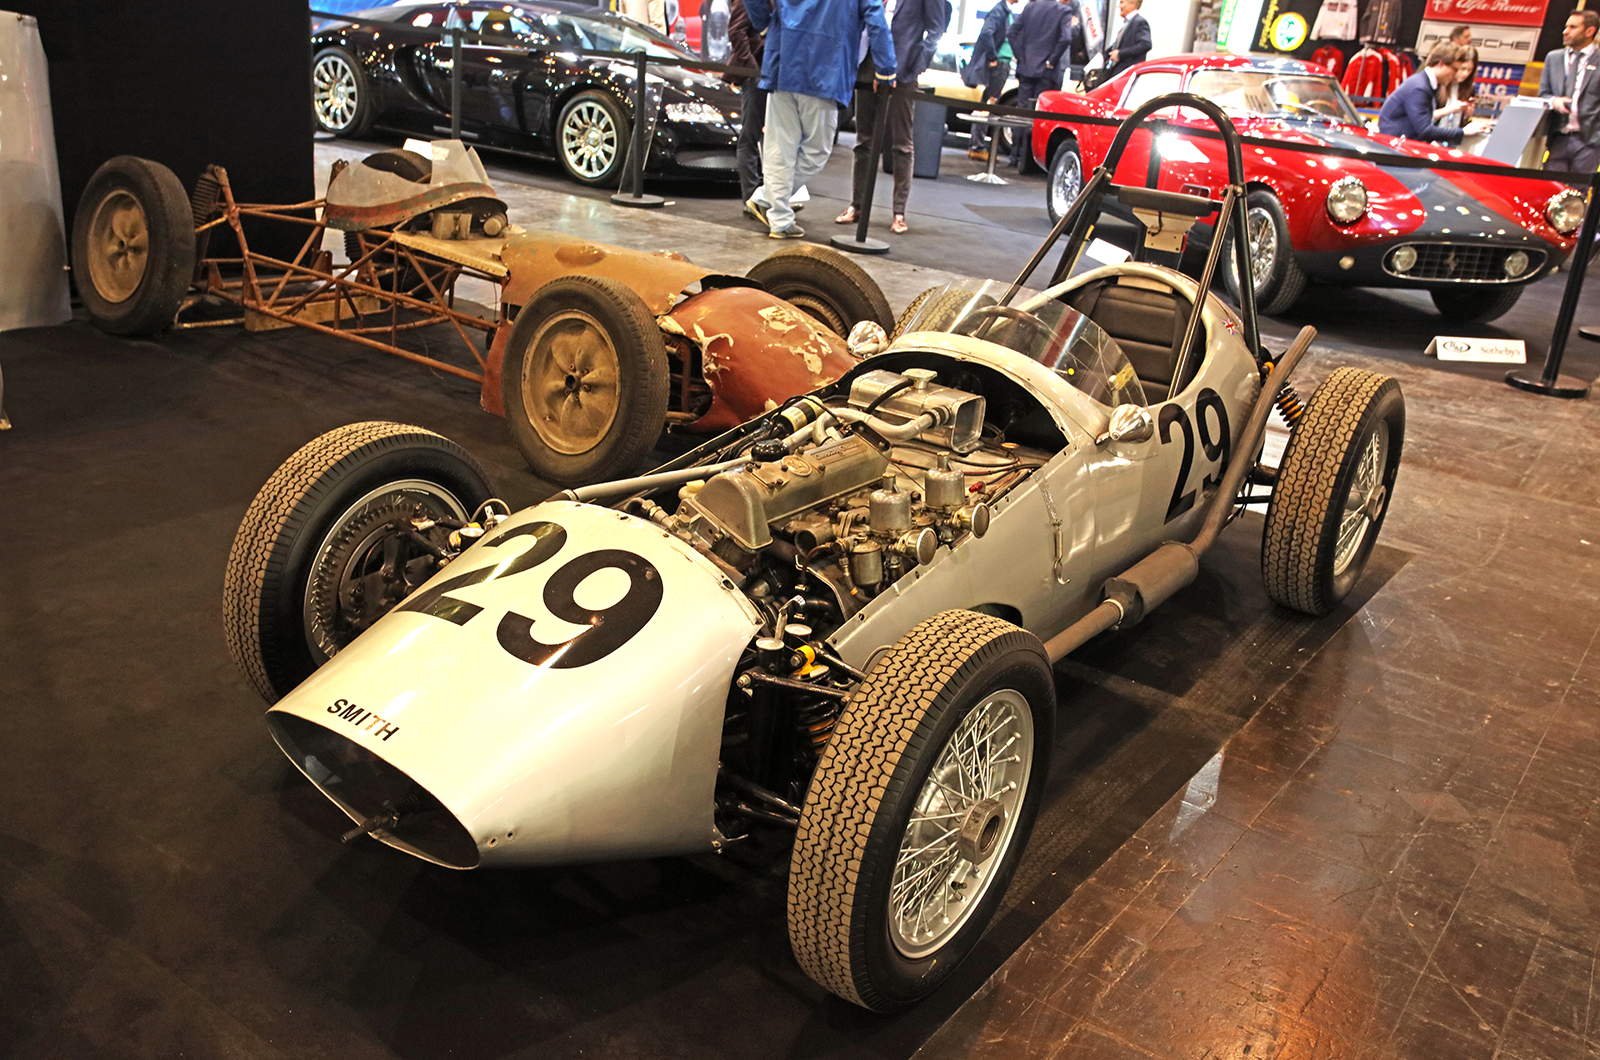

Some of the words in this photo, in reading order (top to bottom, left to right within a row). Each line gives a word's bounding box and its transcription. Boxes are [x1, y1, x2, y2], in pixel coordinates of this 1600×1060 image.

[1490, 0, 1542, 13] Romeo
[1423, 34, 1531, 51] PSCHE
[1158, 387, 1231, 525] 29
[391, 521, 664, 669] 29
[326, 698, 400, 741] SMITH
